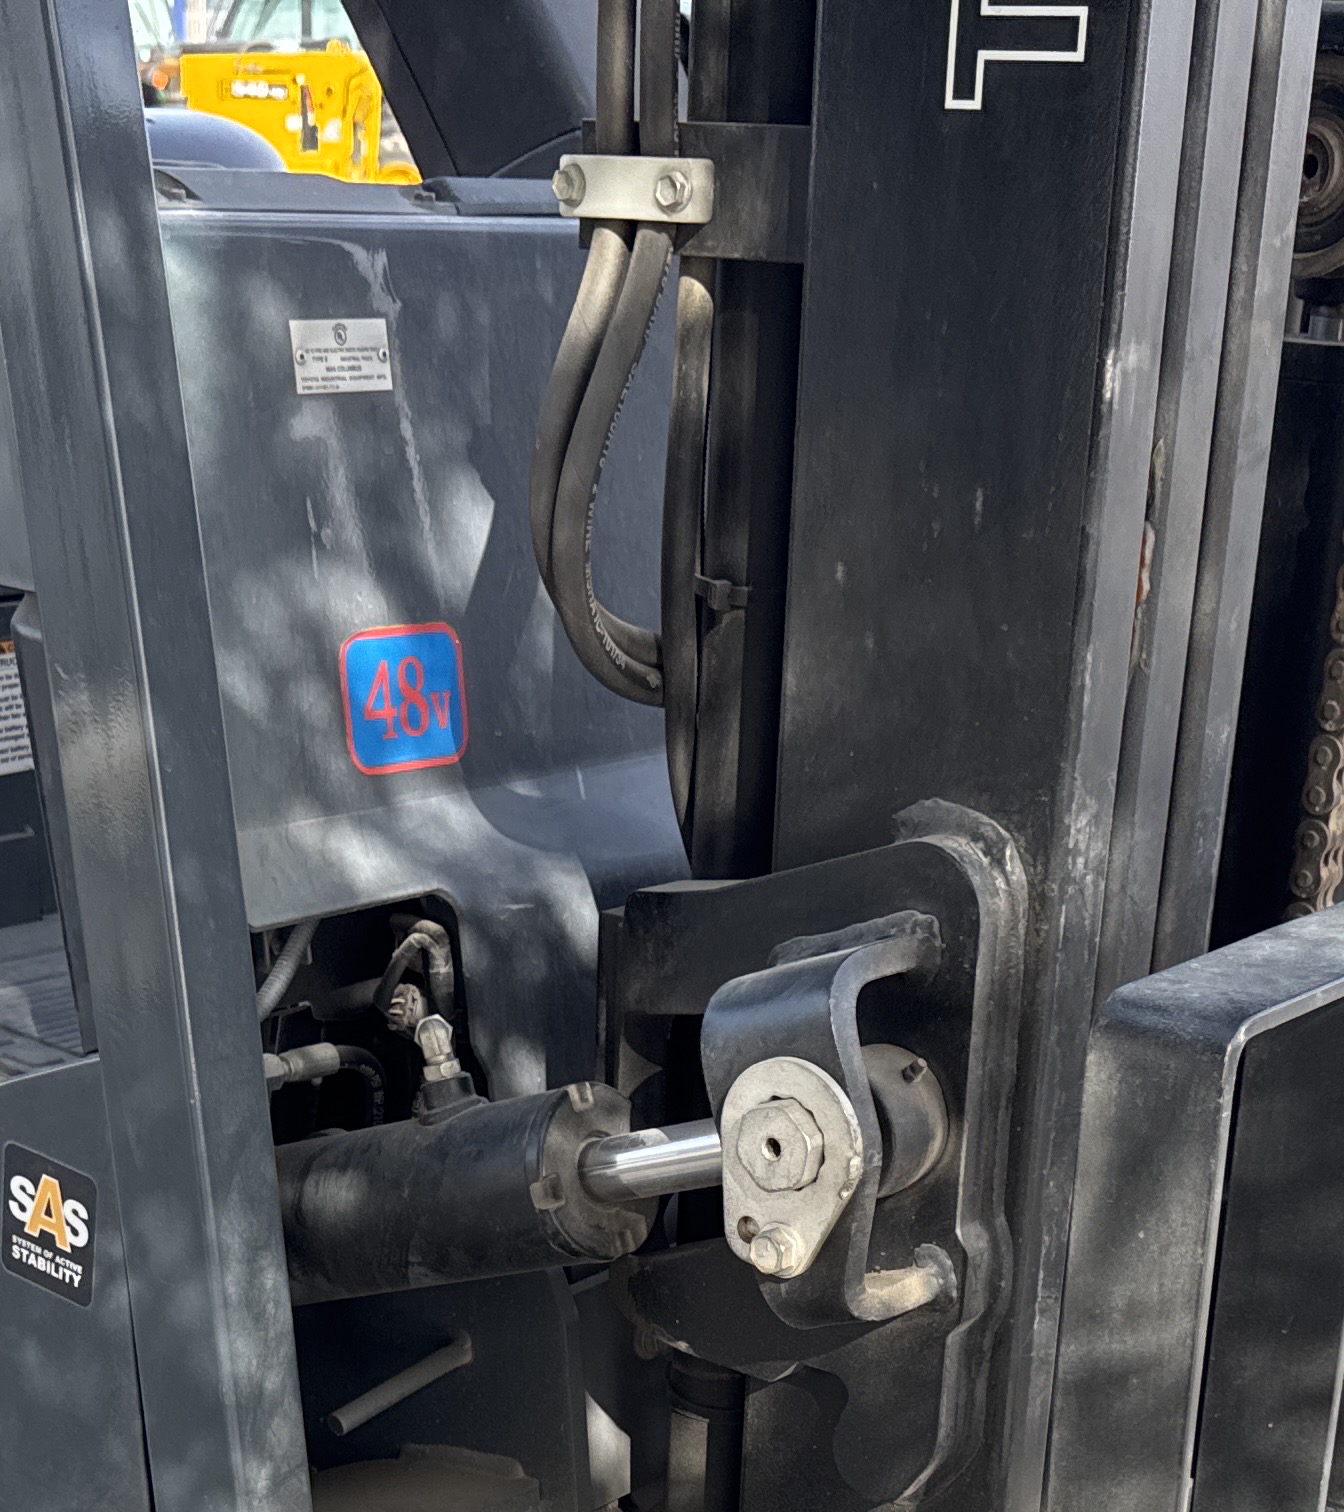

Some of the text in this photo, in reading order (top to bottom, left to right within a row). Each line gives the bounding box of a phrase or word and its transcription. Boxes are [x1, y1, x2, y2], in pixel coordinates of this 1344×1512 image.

[8, 1174, 89, 1253] SAS
[11, 1234, 83, 1275] SYSTEM OF ACTIVE
[11, 1245, 82, 1288] STABILITY
